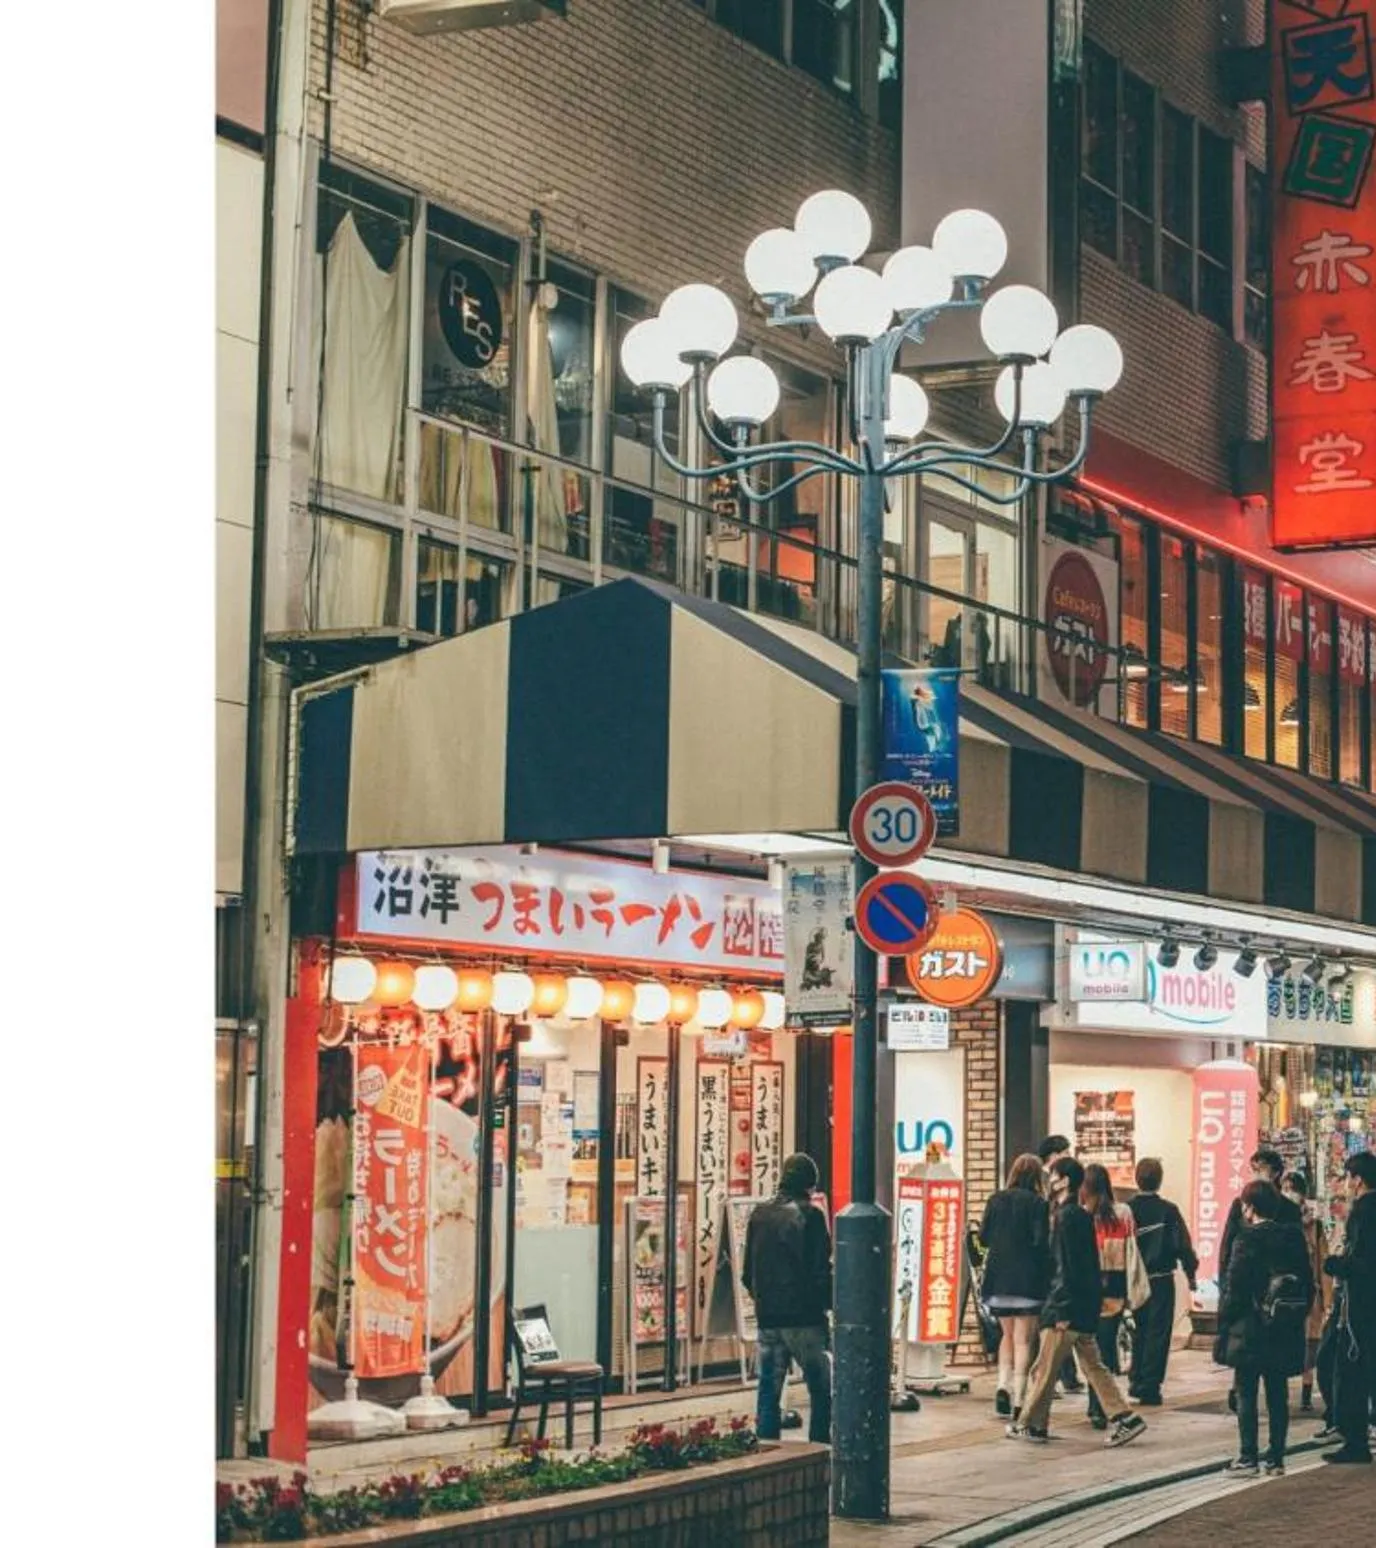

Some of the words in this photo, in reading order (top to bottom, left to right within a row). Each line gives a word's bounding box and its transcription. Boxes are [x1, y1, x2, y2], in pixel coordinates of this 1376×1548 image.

[872, 808, 916, 843] 30
[373, 866, 461, 925] 沼津
[919, 950, 989, 979] ガスト
[1162, 971, 1237, 1020] mobile
[1199, 1090, 1226, 1145] UQ
[1198, 1151, 1219, 1258] mobile
